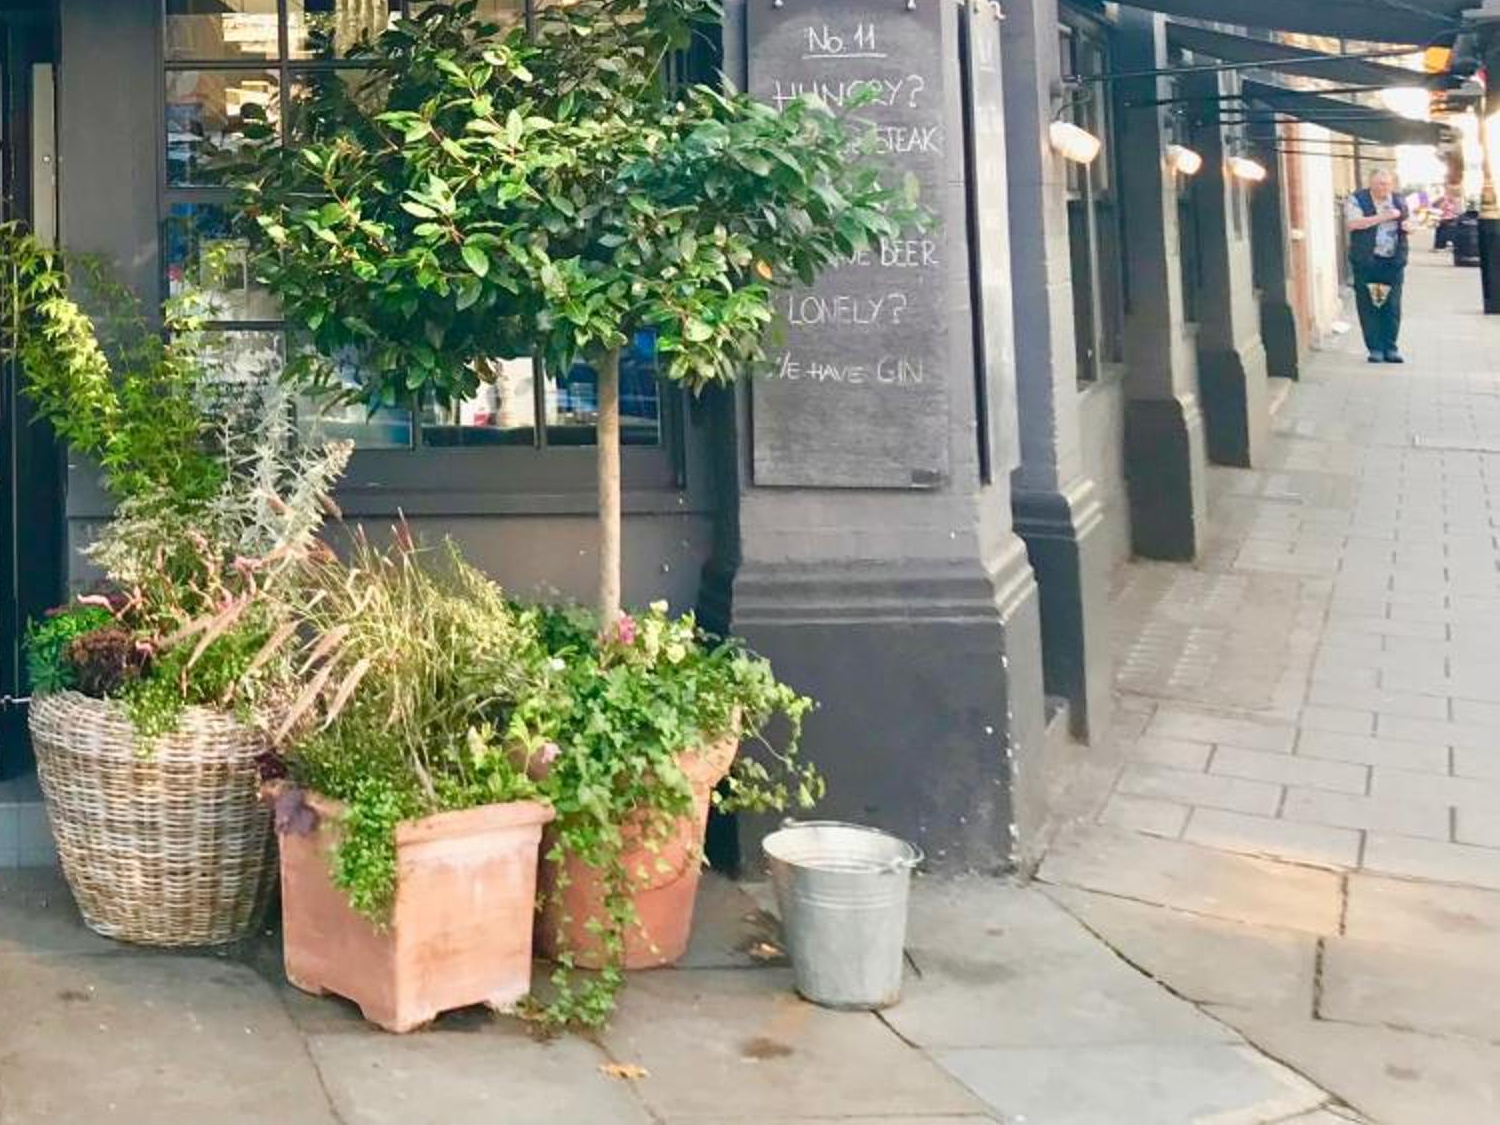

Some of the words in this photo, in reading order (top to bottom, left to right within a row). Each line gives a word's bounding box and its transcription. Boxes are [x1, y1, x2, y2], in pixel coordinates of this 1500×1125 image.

[880, 236, 940, 267] BEER
[787, 293, 908, 325] LONELY?
[805, 361, 864, 384] HAVE
[877, 352, 923, 386] GIN
